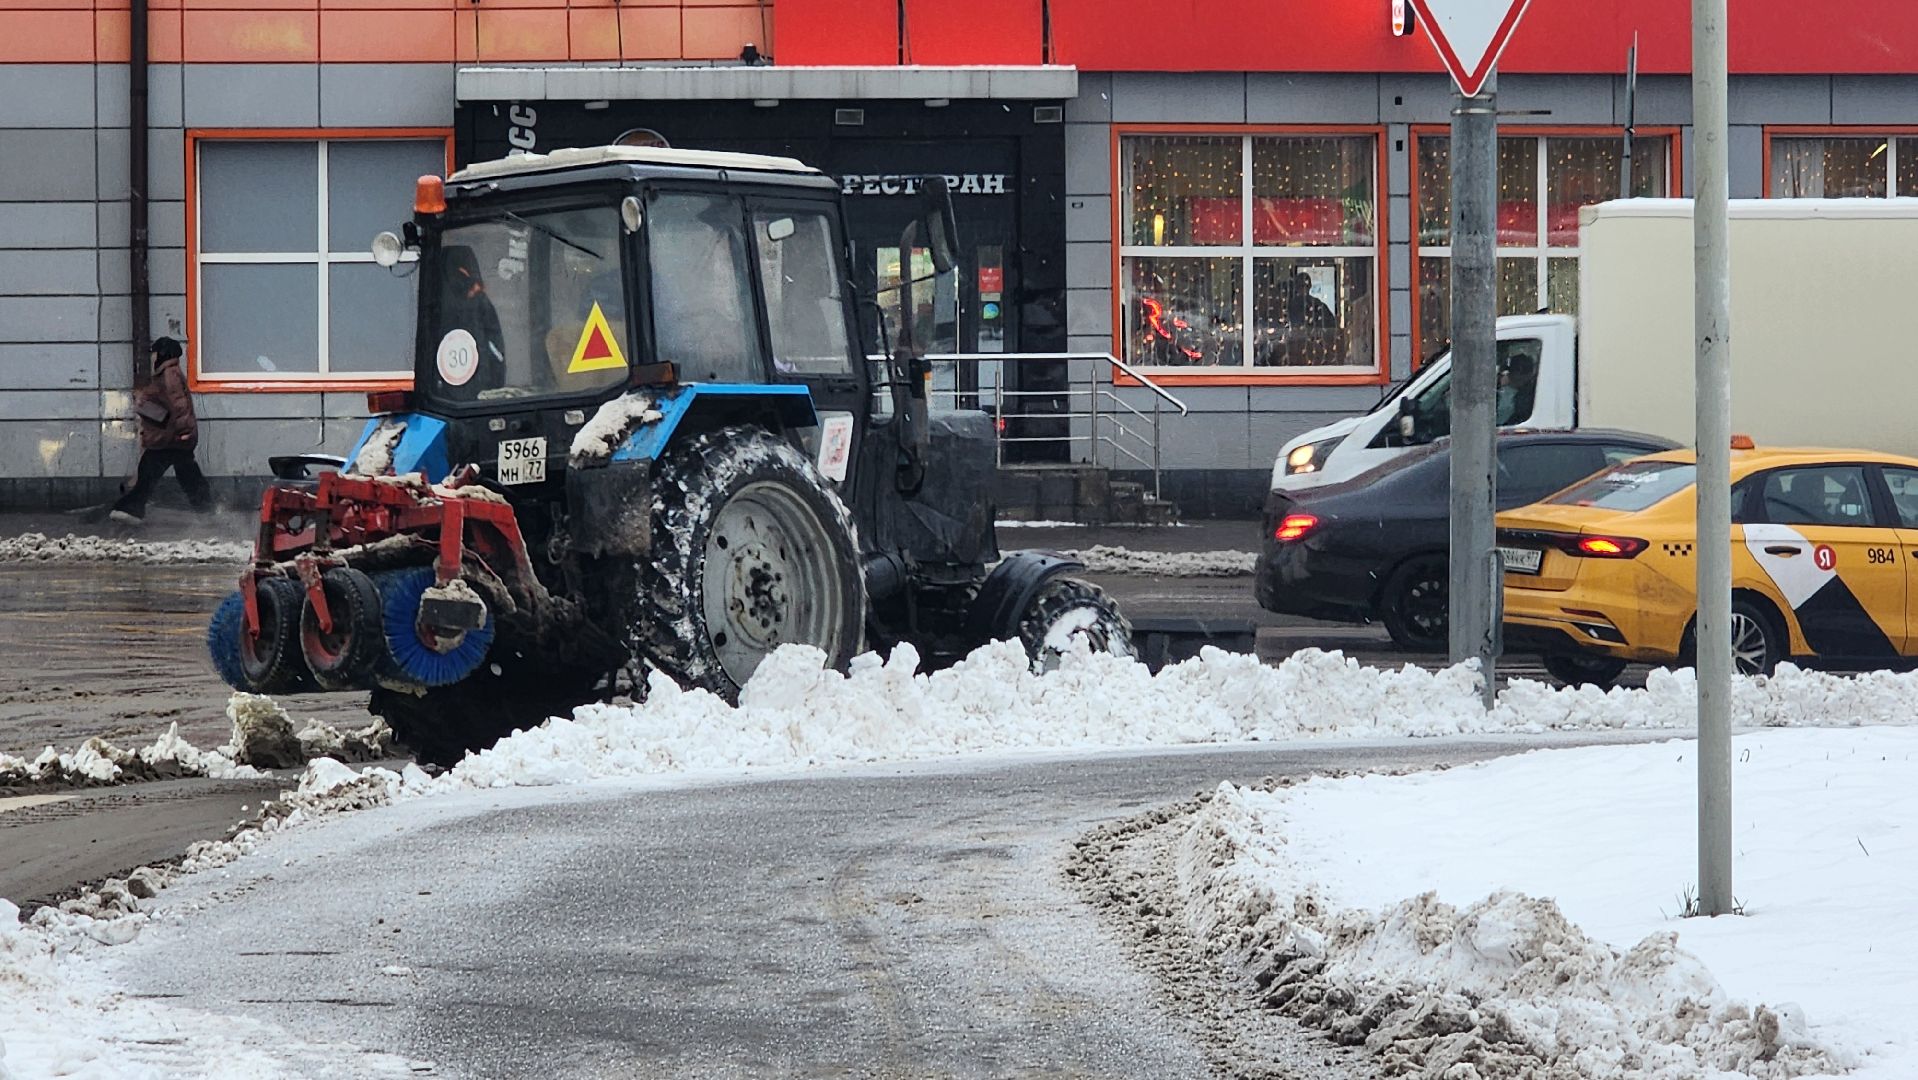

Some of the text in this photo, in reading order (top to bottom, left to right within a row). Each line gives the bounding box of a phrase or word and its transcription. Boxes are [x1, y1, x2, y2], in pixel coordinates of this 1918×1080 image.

[841, 174, 1005, 195] РЕСТРАН
[449, 347, 468, 368] 30
[504, 440, 540, 460] 5966
[501, 461, 542, 481] МН 77
[1819, 548, 1831, 567] Я
[1867, 548, 1895, 564] 984
